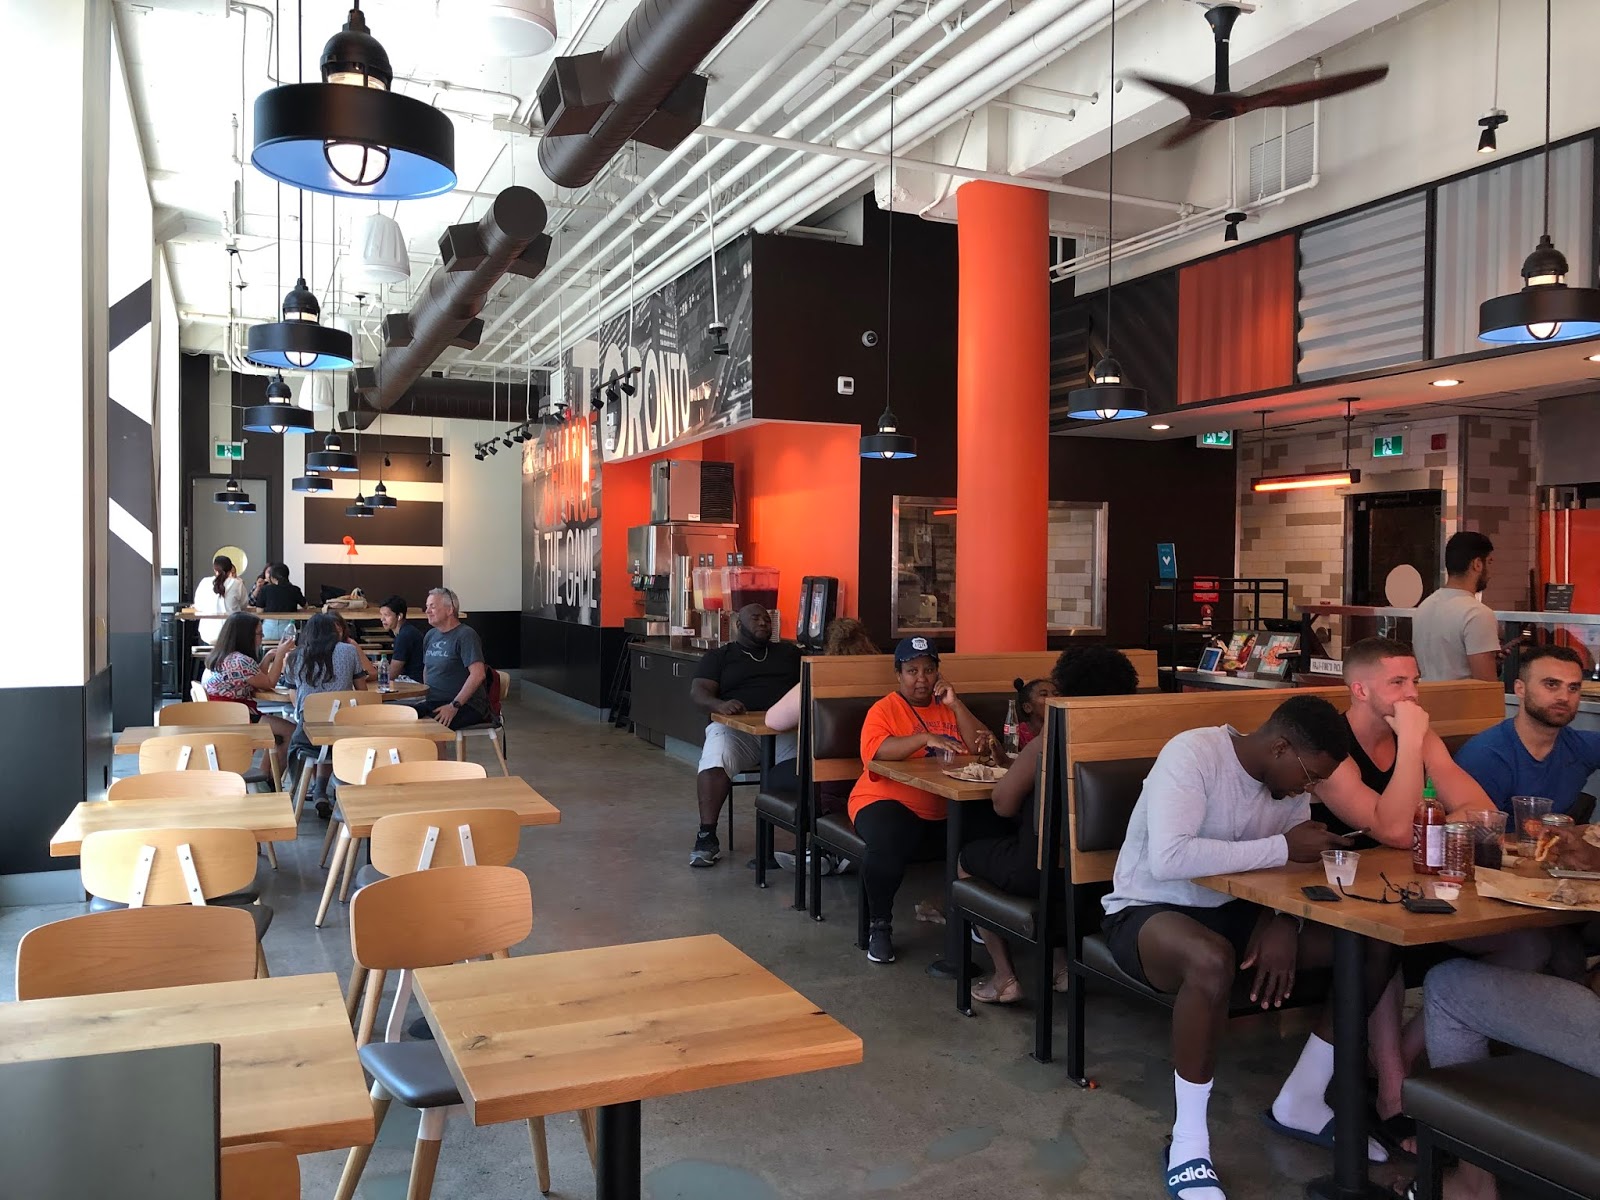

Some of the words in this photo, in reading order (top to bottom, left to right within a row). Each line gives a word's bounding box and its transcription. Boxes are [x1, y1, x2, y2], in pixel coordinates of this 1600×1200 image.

[572, 338, 691, 463] TORONTO
[544, 530, 562, 605] THE
[566, 528, 598, 608] GAME
[1168, 1164, 1219, 1186] adida
